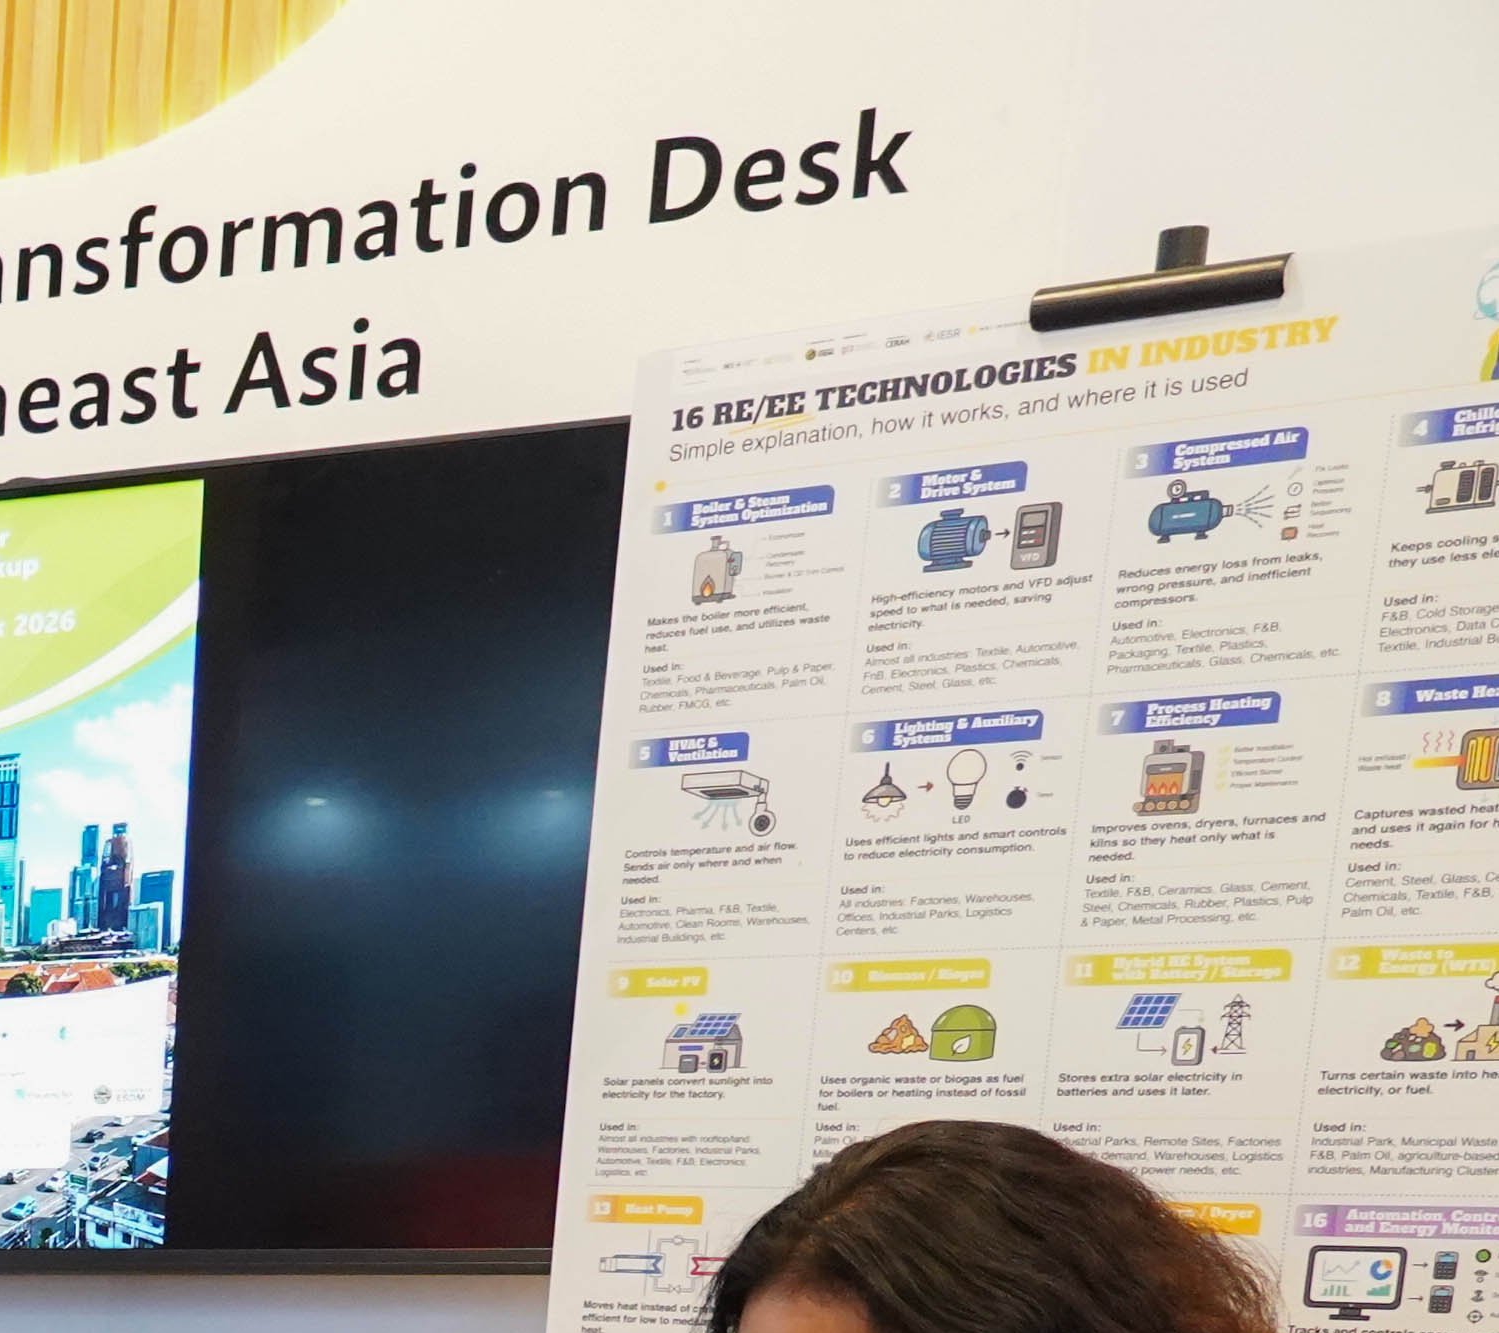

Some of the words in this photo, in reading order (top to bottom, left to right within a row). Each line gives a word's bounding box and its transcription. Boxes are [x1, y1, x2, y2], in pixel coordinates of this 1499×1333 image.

[649, 107, 911, 223] Desk
[1087, 345, 1130, 374] IN
[1140, 316, 1338, 366] INDUSTRY
[224, 317, 420, 413] Asia
[672, 406, 703, 431] 16
[712, 391, 805, 425] RE/EE
[815, 353, 1076, 411] TECHNOLOGIES
[670, 438, 734, 462] Simple
[742, 423, 862, 453] explanation,
[872, 417, 914, 434] how
[922, 411, 933, 427] it
[941, 403, 1008, 425] works,
[1018, 393, 1059, 415] and
[1068, 387, 1136, 408] where
[1144, 381, 1156, 398] it
[1164, 378, 1182, 396] is
[1191, 367, 1248, 393] used
[1175, 433, 1270, 456] Compressed
[1272, 431, 1300, 445] Air
[1135, 454, 1148, 469] 3
[1172, 453, 1230, 470] System
[920, 485, 960, 498] Drive
[962, 479, 1016, 495] System
[922, 473, 968, 486] Motor
[888, 485, 902, 499] 2
[690, 513, 738, 528] System
[741, 501, 827, 522] Optimization
[692, 501, 732, 515] Boiler
[748, 495, 790, 508] Steam
[1019, 552, 1040, 562] VFD
[1118, 567, 1170, 578] Reduces
[1175, 563, 1217, 574] energy
[1222, 560, 1248, 569] loss
[1252, 556, 1281, 566] from
[1285, 552, 1322, 562] leaks,
[14, 609, 75, 635] 2026
[1416, 689, 1473, 702] Waste
[1146, 702, 1206, 715] Process
[1209, 696, 1272, 711] Heating
[895, 720, 954, 736] Lighting
[971, 714, 1038, 728] Auxiliary
[1110, 710, 1125, 726] 7
[1145, 713, 1221, 727] Efficiency
[668, 737, 705, 751] HVAC
[862, 729, 875, 744] 6
[892, 733, 951, 748] Systems
[668, 748, 738, 762] Ventilation
[951, 815, 971, 824] LED
[1092, 824, 1147, 834] Improves
[1151, 821, 1191, 830] ovens,
[1195, 819, 1238, 829] dryers,
[1243, 816, 1297, 825] furnaces
[1302, 812, 1326, 822] and
[846, 838, 872, 846] Uses
[875, 835, 920, 845] efficient
[924, 833, 954, 844] lights
[958, 831, 979, 840] and
[982, 830, 1015, 839] smart
[1018, 826, 1066, 837] controls
[1058, 1073, 1096, 1082] Stores
[1100, 1074, 1129, 1082] extra
[1134, 1072, 1164, 1082] solar
[1167, 1072, 1227, 1083] electricity
[1231, 1072, 1242, 1080] in
